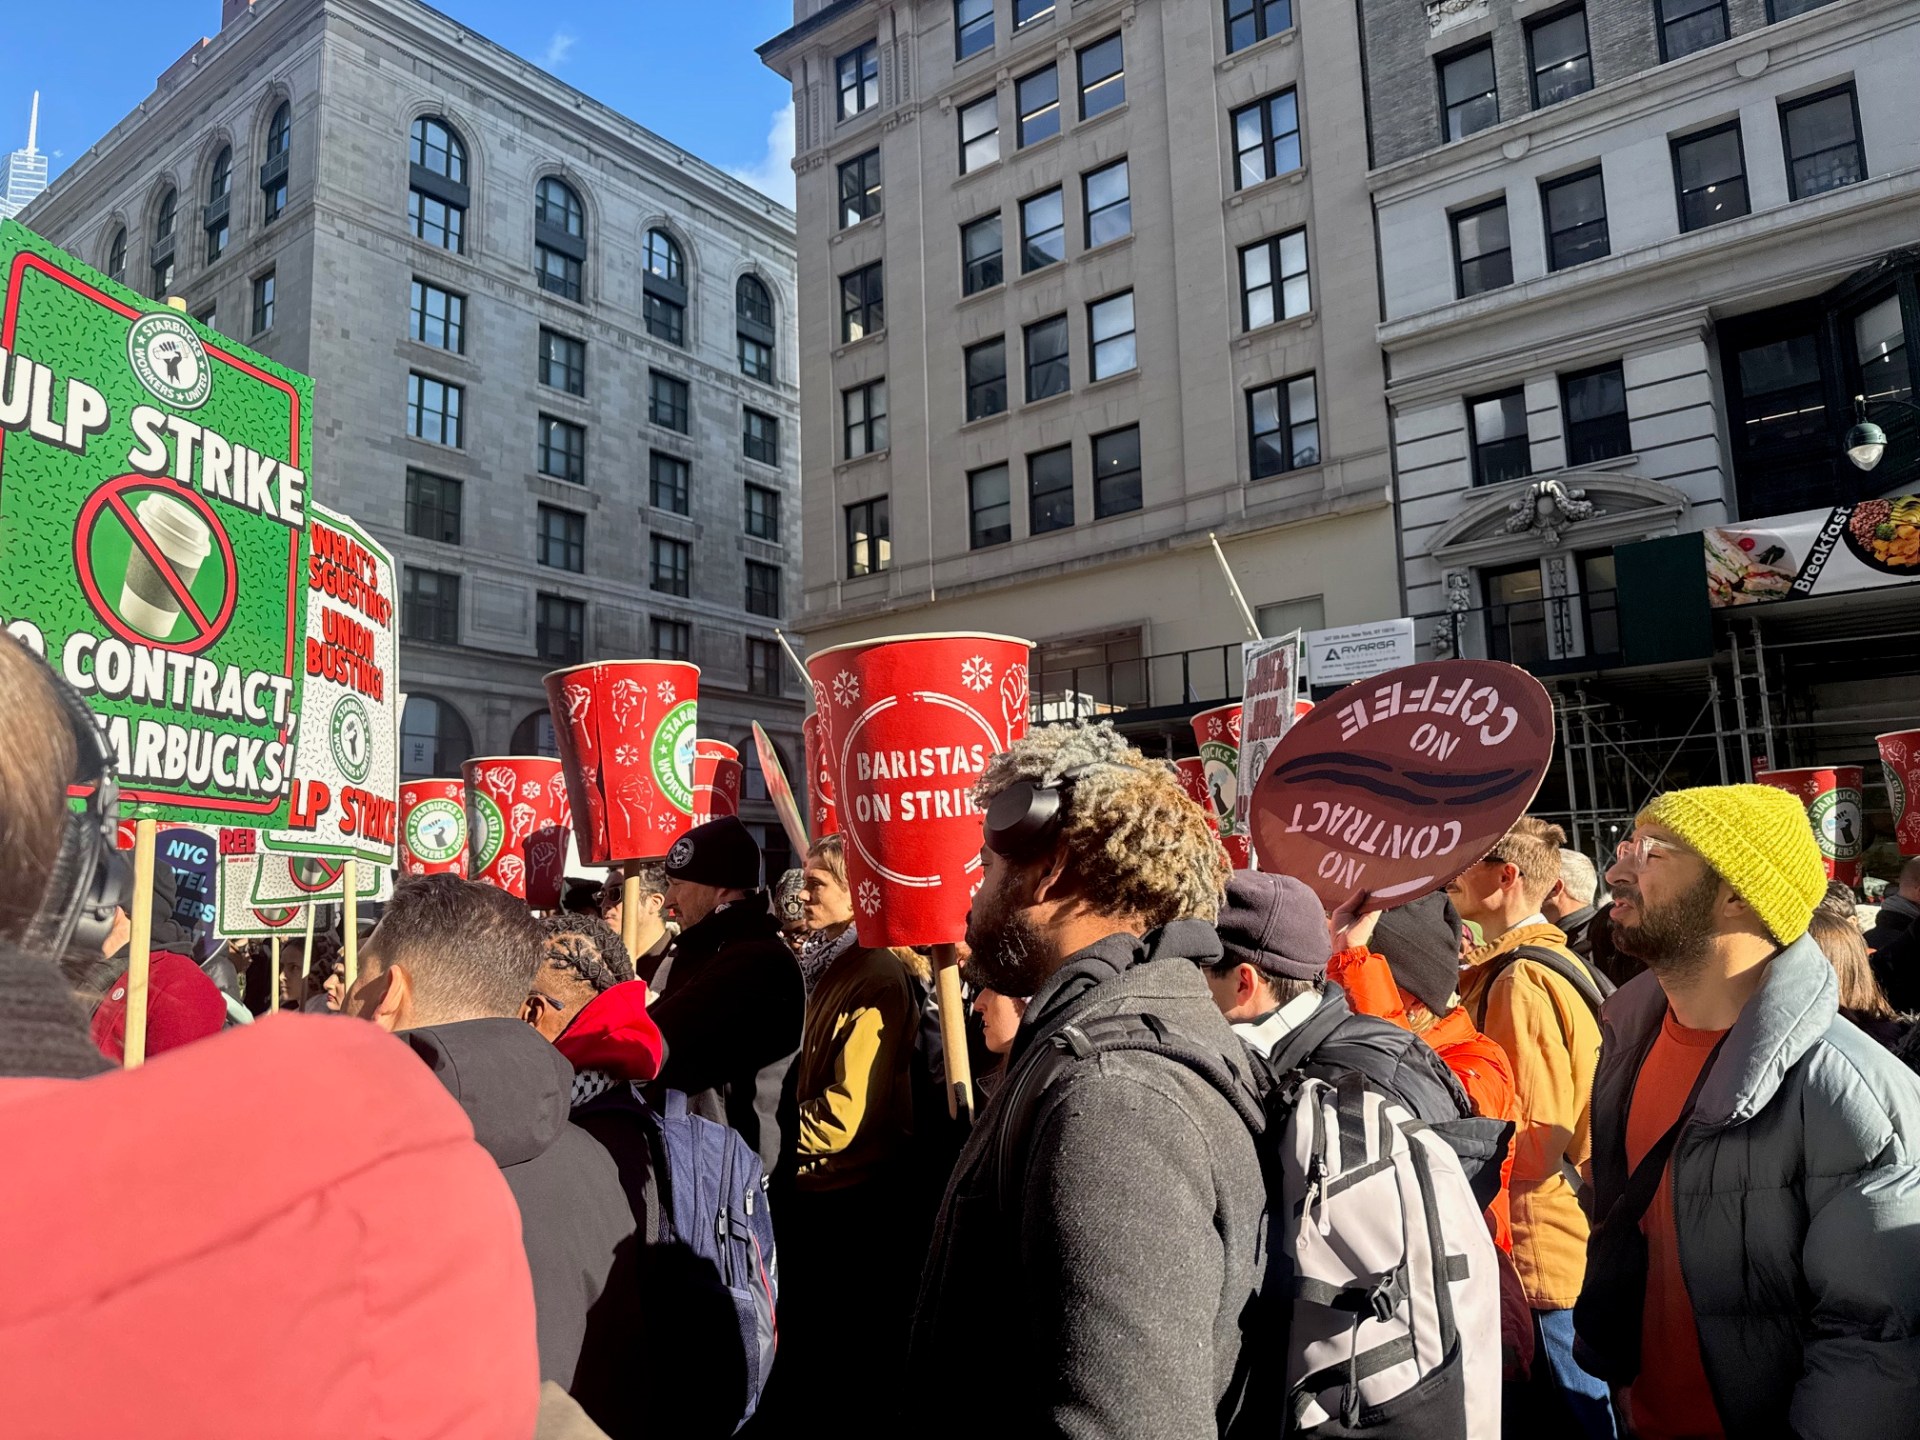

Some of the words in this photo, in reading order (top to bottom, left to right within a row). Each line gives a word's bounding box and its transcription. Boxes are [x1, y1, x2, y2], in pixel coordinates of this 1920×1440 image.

[142, 320, 203, 358] STARBUCKS
[134, 348, 175, 399] WORKERS
[184, 372, 207, 401] UNITED
[0, 345, 110, 453] ULP
[127, 403, 306, 527] STRIKE
[311, 520, 378, 589] WHAT'S
[1793, 506, 1852, 592] Breakfast
[309, 555, 393, 632] SGUSTING?
[322, 606, 374, 663] UNION
[1341, 640, 1396, 654] AVARGA
[62, 632, 298, 737] CONTRACT,
[306, 637, 384, 704] BUSTING!
[337, 701, 368, 729] STARBUCKS
[1336, 675, 1518, 746] COFFEE
[333, 734, 356, 777] WORKERS
[414, 742, 425, 763] THE
[856, 744, 985, 780] BARISTAS
[1201, 746, 1231, 762] BUCKS
[1409, 723, 1460, 762] NO
[658, 758, 694, 807] WORKE
[289, 778, 330, 831] LP
[339, 786, 398, 847] STRIKE
[411, 801, 459, 827] STARBUCKS
[856, 793, 892, 822] ON
[900, 787, 987, 821] STRIK
[410, 833, 446, 859] WORKERS
[480, 816, 500, 861] UNITED
[1284, 801, 1462, 859] CONTRACT
[166, 839, 209, 865] NYC
[1318, 851, 1366, 889] NO
[172, 866, 208, 894] TEL
